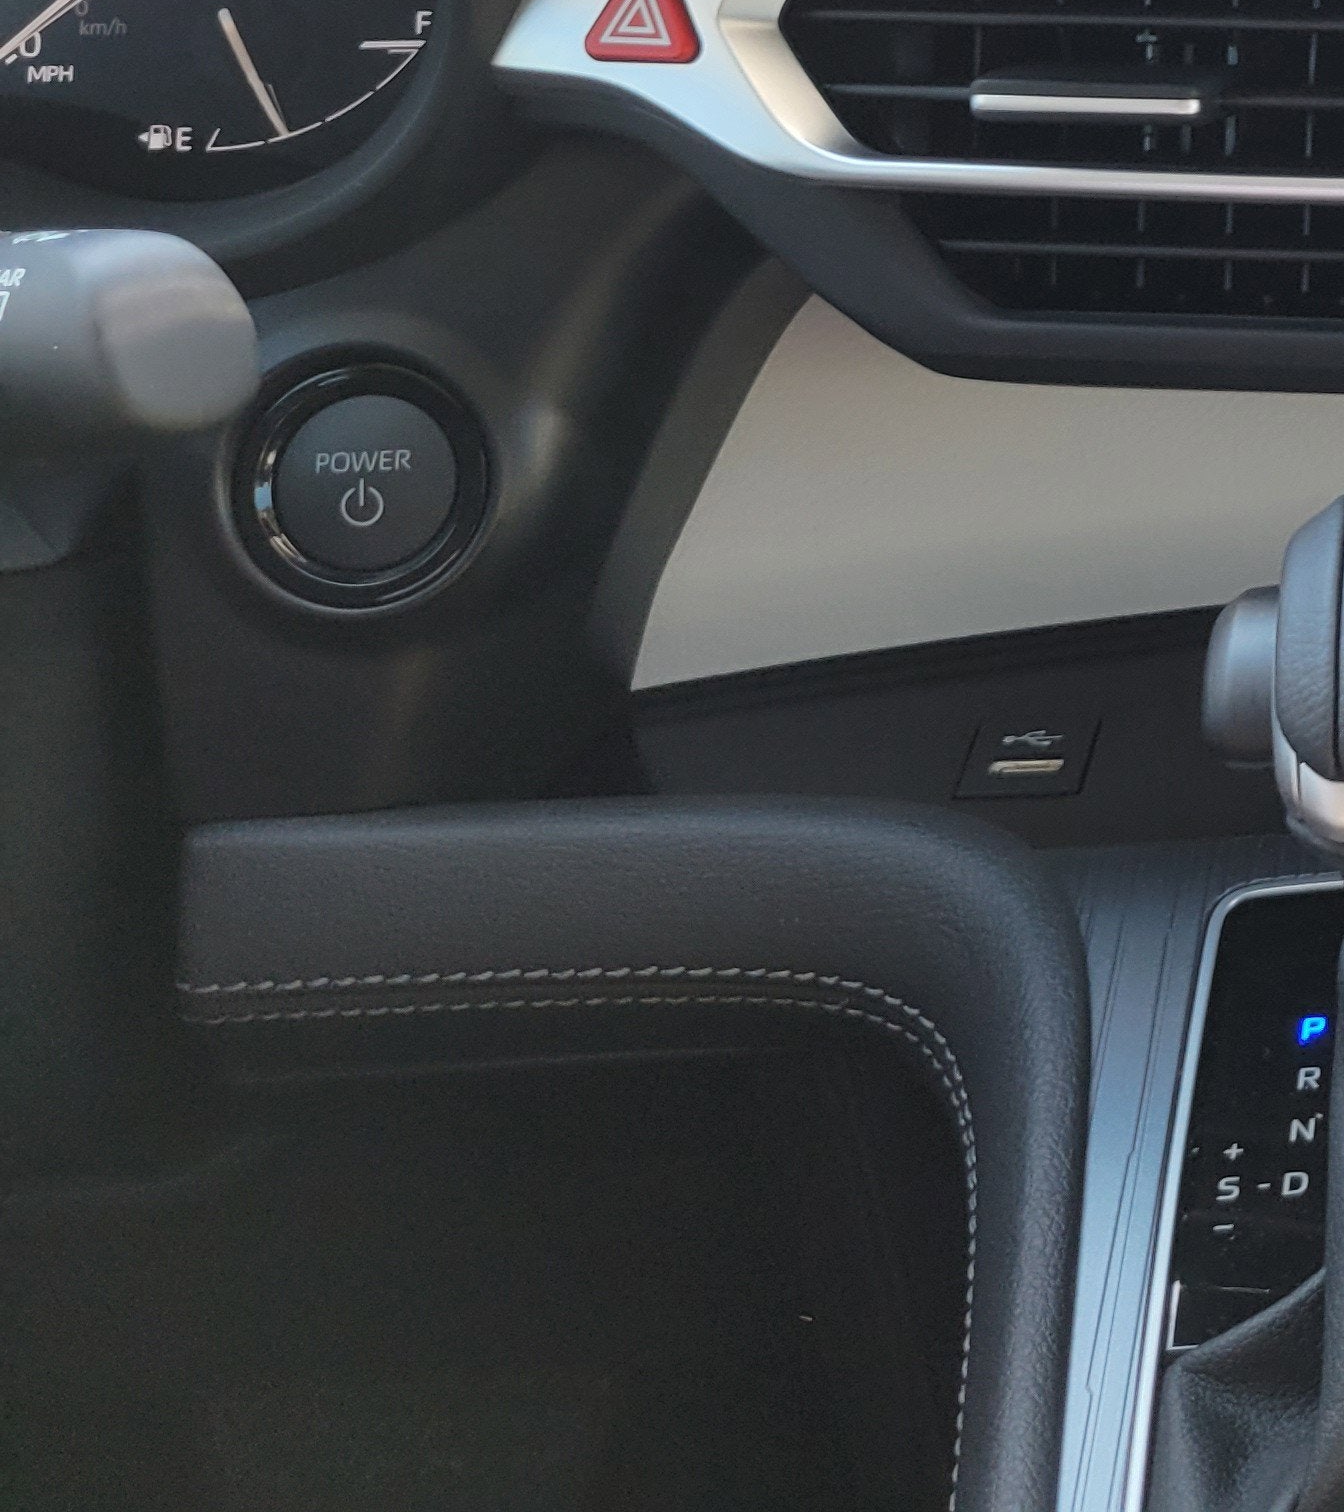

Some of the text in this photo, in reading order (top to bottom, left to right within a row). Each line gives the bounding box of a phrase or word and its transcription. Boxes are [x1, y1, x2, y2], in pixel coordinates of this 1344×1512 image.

[79, 17, 127, 36] km/h
[414, 10, 432, 34] F
[27, 64, 75, 84] MPH
[175, 127, 193, 152] E
[315, 449, 412, 474] POWER
[1299, 1015, 1328, 1044] P
[1297, 1066, 1322, 1090] R
[1288, 1117, 1317, 1143] N
[1215, 1171, 1310, 1202] S D
